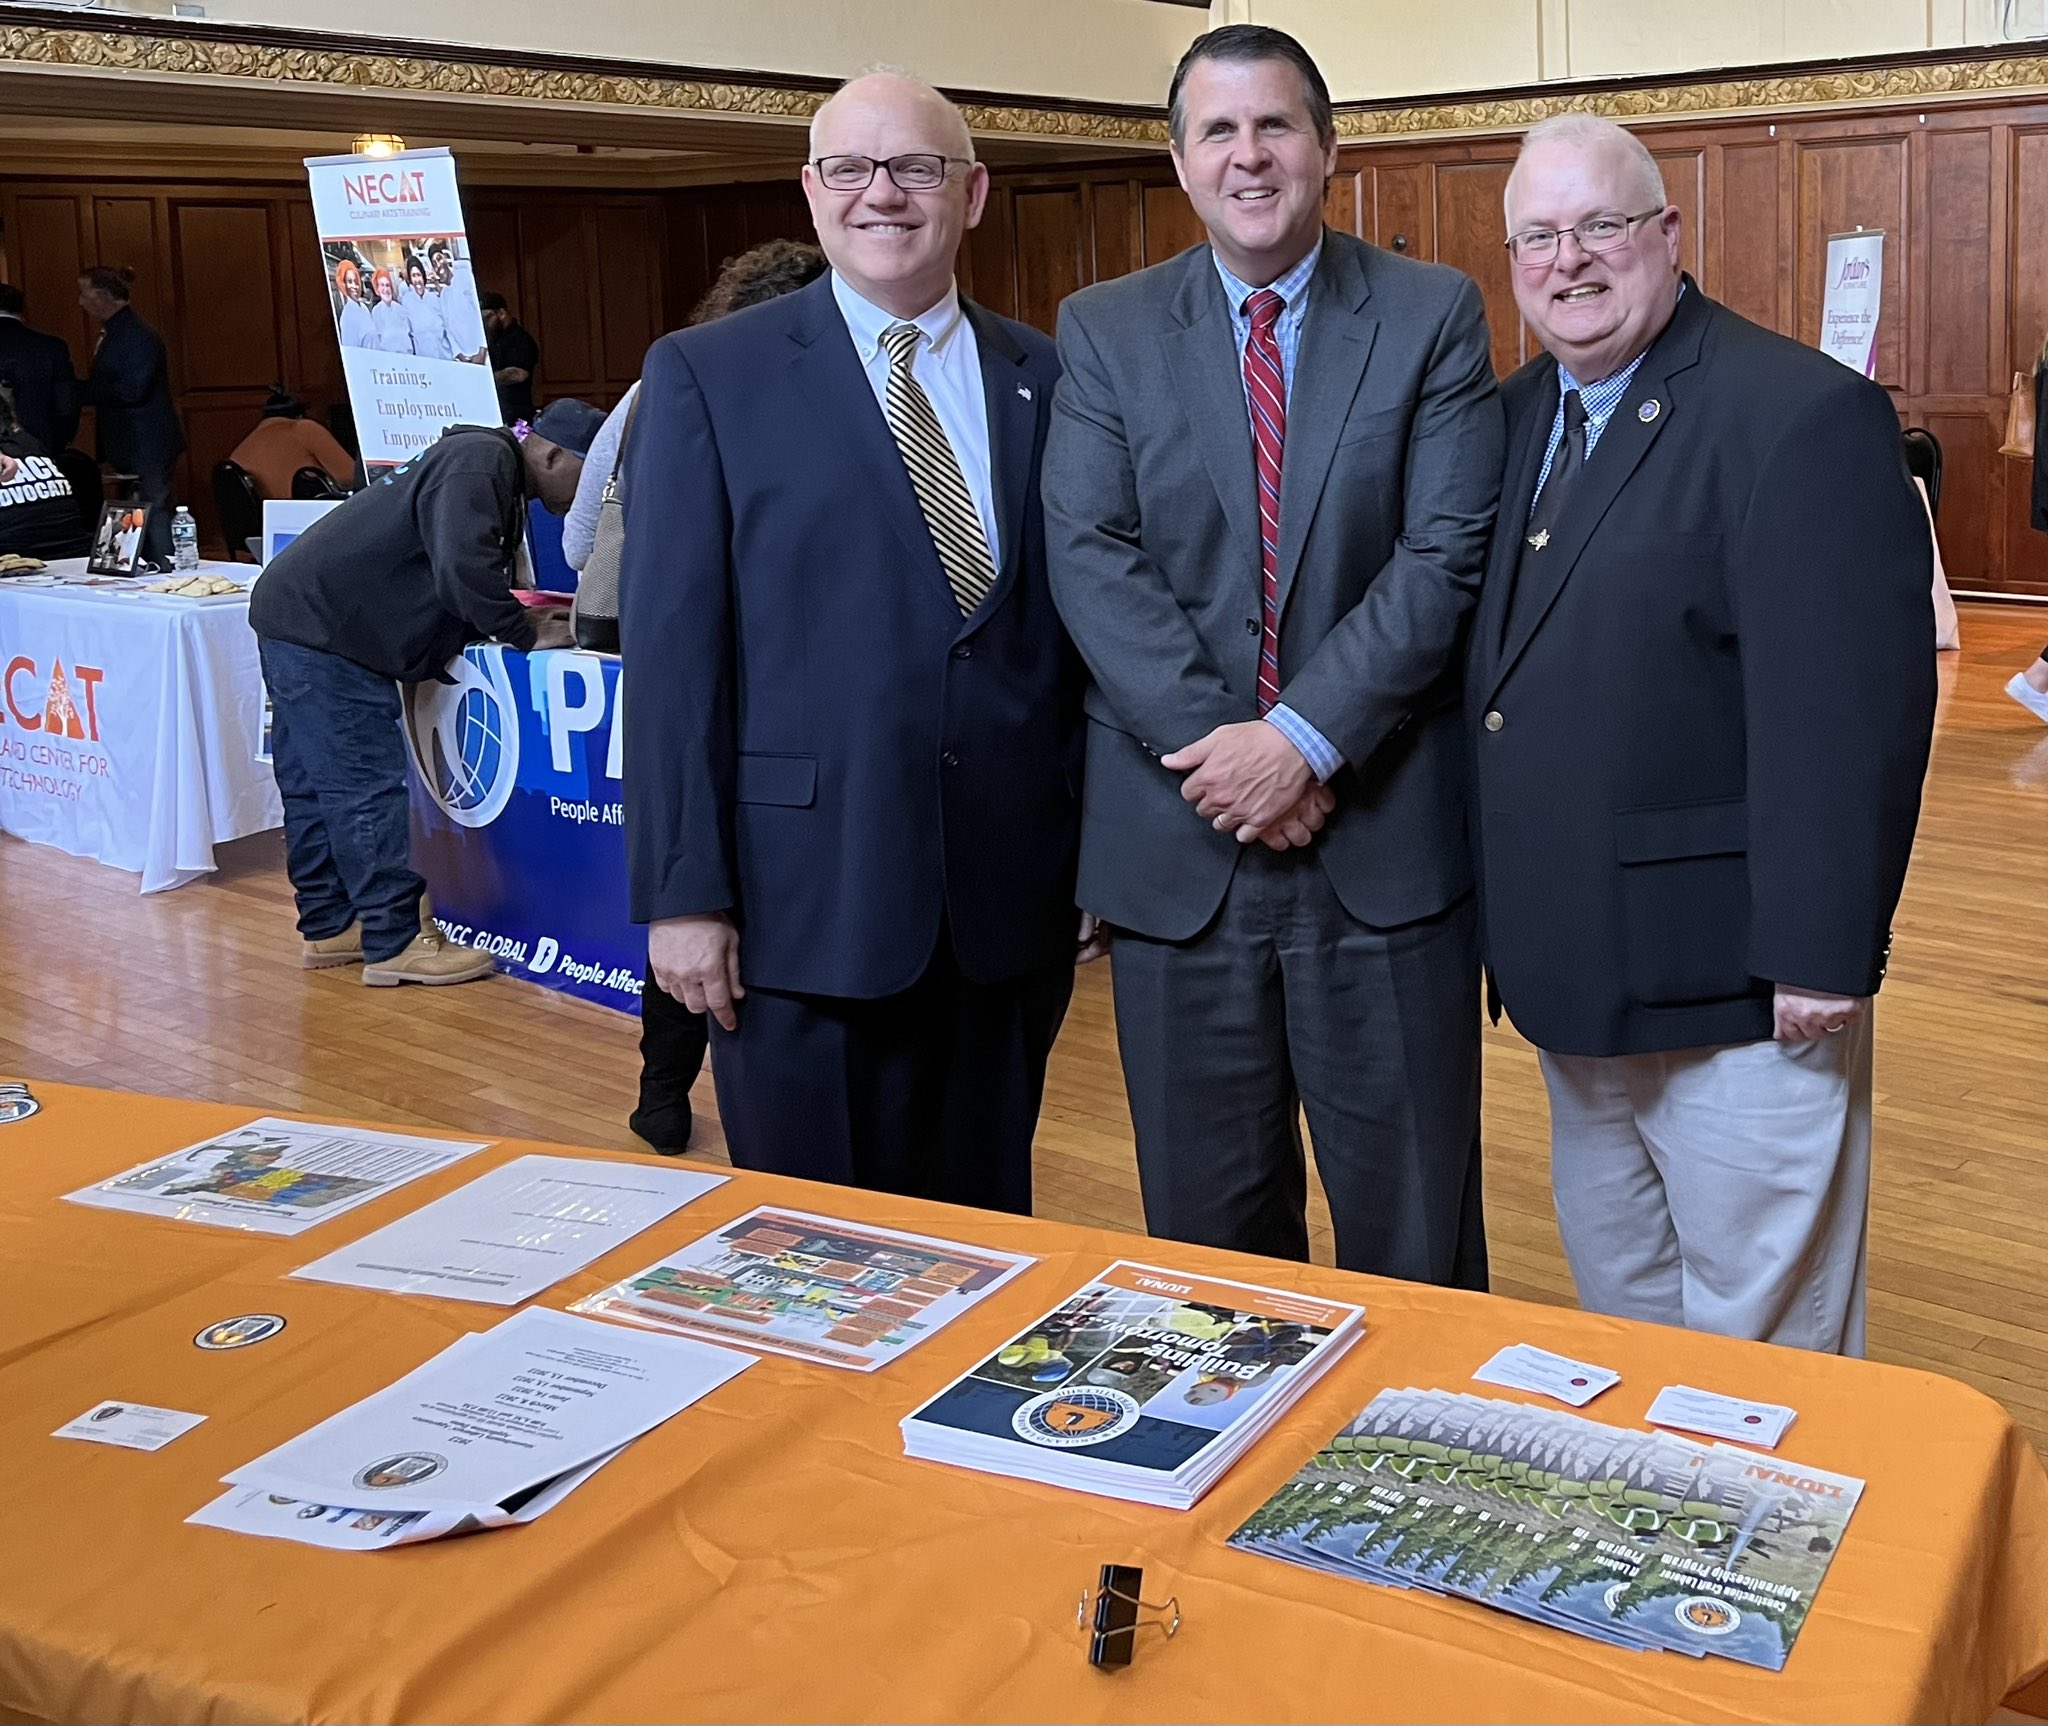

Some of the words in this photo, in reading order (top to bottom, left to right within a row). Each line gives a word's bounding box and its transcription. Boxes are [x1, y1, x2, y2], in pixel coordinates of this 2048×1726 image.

[343, 170, 425, 206] NECAT
[369, 368, 432, 389] Training.
[376, 398, 462, 420] Employment.
[0, 479, 73, 507] DVOCATE
[0, 656, 103, 742] CAT
[0, 738, 26, 761] AND
[79, 754, 110, 778] FOR
[0, 766, 82, 801] TECHNOLOGY
[551, 796, 599, 825] People
[602, 804, 625, 826] Aff
[472, 931, 528, 963] GLOBAL
[557, 954, 605, 984] People
[603, 967, 646, 995] Affec
[1135, 1277, 1193, 1295] LIUNA!
[1088, 1316, 1232, 1358] Tomorrow...
[1143, 1343, 1261, 1380] Building
[1370, 1485, 1405, 1503] ogram
[1744, 1464, 1844, 1499] LIUNA!
[1363, 1499, 1396, 1515] aborer
[1592, 1555, 1631, 1575] Laborer
[1595, 1540, 1646, 1565] Program
[1660, 1553, 1711, 1577] Program
[1658, 1569, 1698, 1588] Laborer
[1697, 1580, 1723, 1595] Craft
[1710, 1566, 1802, 1602] Apprenticeship
[1723, 1586, 1788, 1613] Construction
